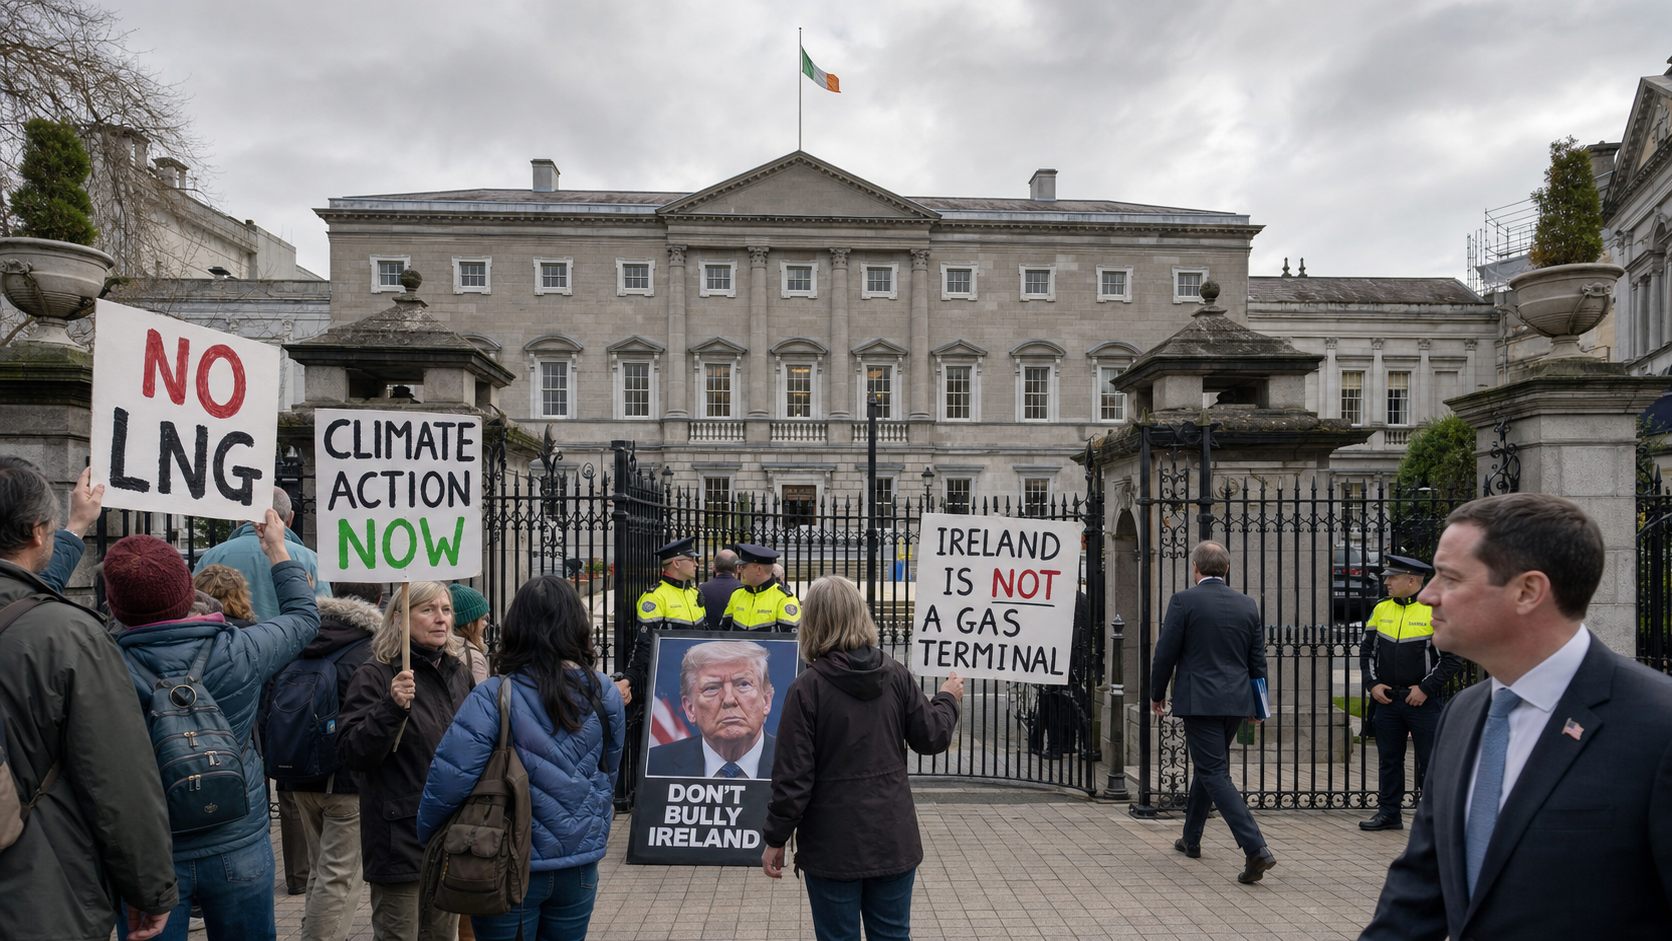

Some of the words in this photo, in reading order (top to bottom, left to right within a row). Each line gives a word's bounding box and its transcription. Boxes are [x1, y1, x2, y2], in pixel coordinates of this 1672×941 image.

[143, 329, 246, 419] NO
[109, 406, 262, 506] LNG
[324, 419, 476, 462] CLIMATE
[328, 470, 470, 511] ACTION
[339, 516, 465, 570] NOW
[936, 527, 1061, 561] IRELAND
[943, 567, 973, 597] IS
[992, 568, 1061, 600] NOT
[922, 604, 942, 633] A
[957, 607, 1021, 637] GAS
[918, 639, 1064, 676] TERMINAL
[664, 805, 743, 827] BULLY
[648, 826, 761, 849] IRELAND
